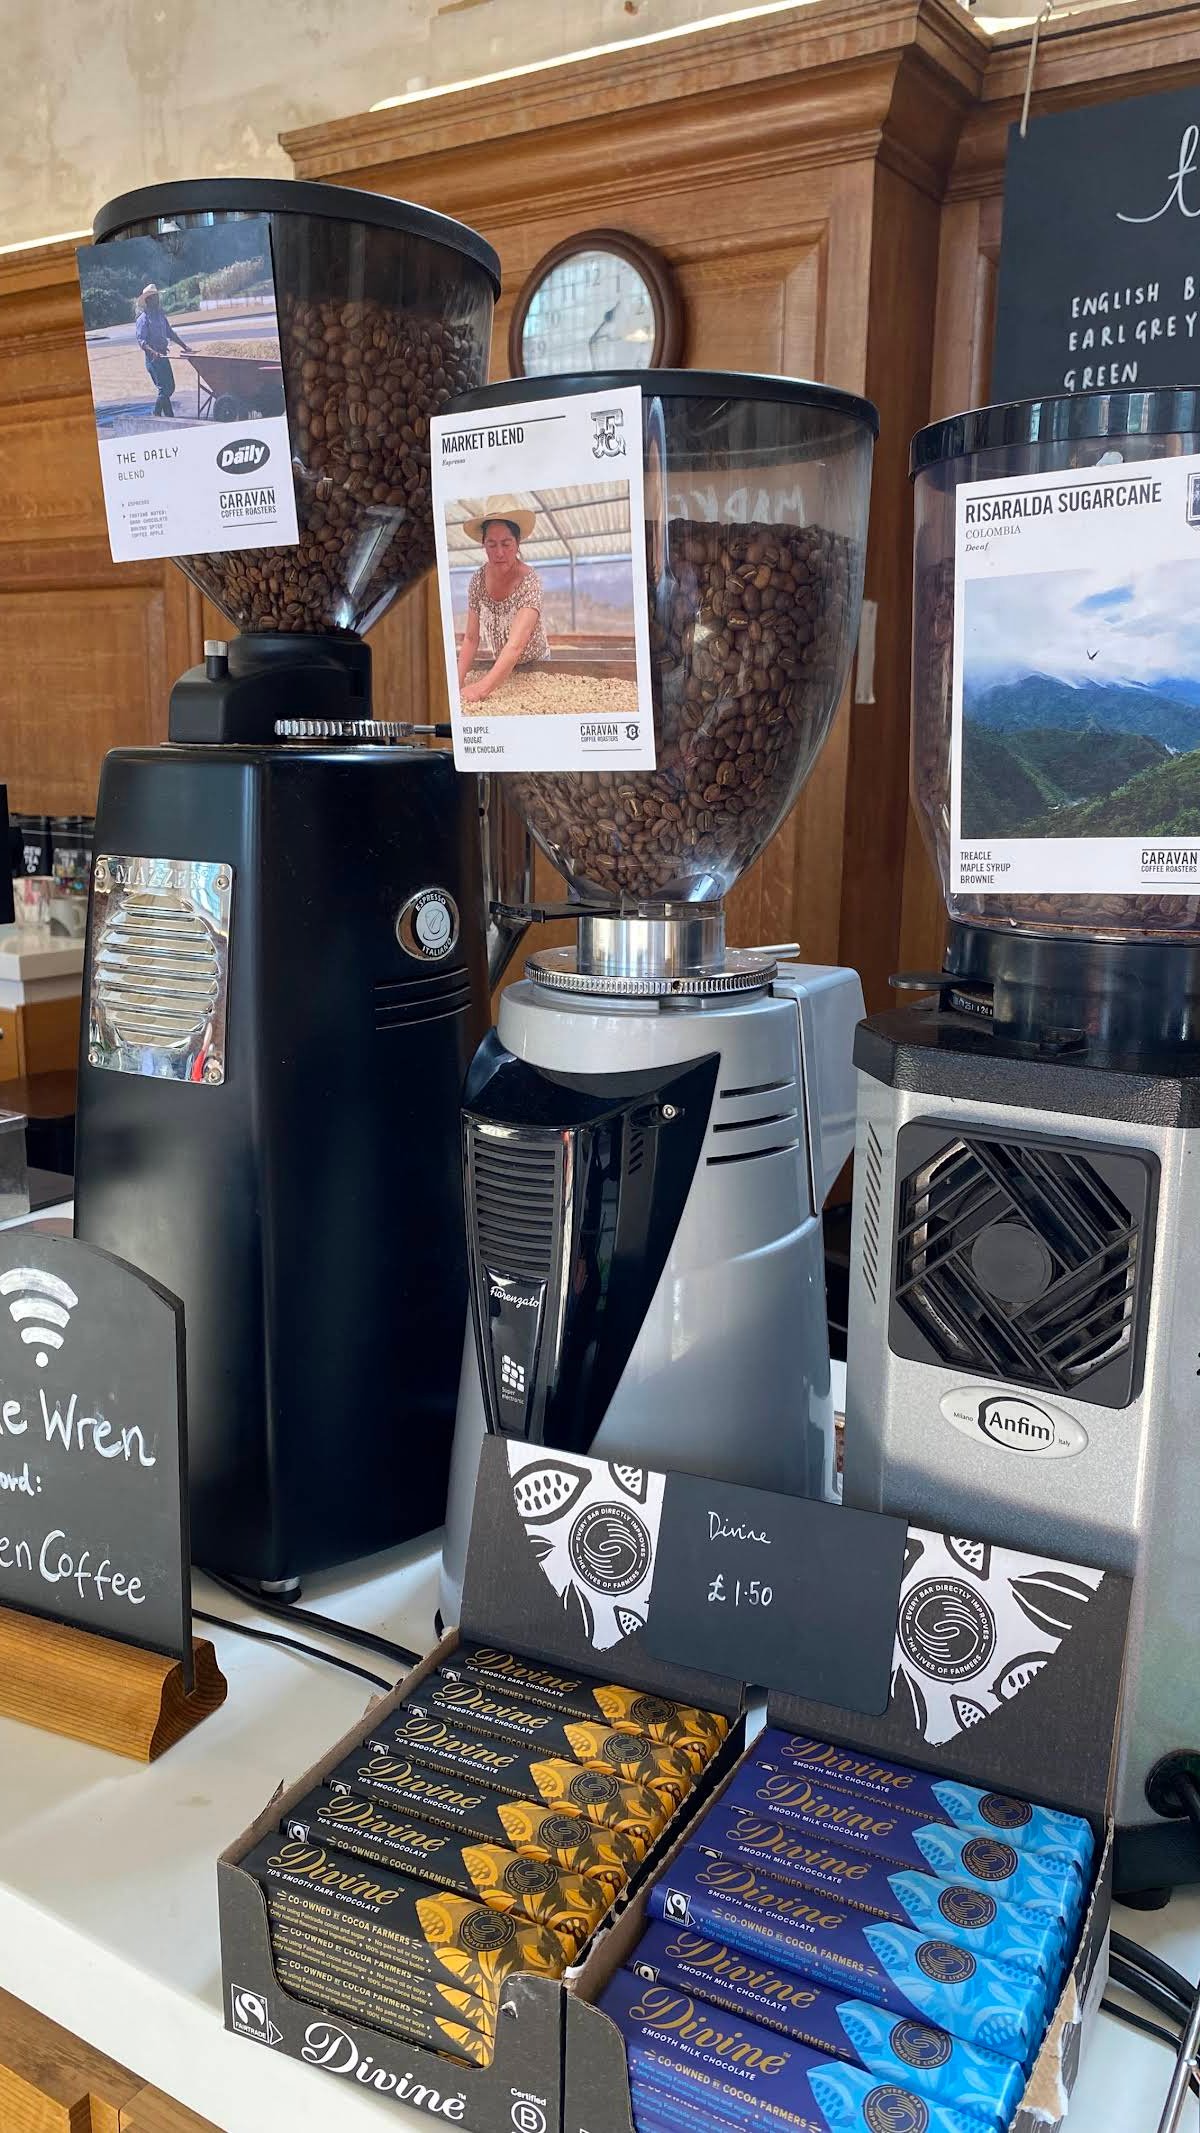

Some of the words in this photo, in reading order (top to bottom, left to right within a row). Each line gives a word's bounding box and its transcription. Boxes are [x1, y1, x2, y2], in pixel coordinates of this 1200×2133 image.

[1072, 282, 1159, 318] ENGLISH
[1069, 324, 1125, 351] EARL
[1136, 311, 1198, 344] GREY
[1064, 361, 1138, 391] GREEN
[117, 453, 136, 464] THE
[144, 447, 179, 461] DAILY
[221, 444, 265, 467] Daily
[442, 433, 484, 454] MARKET
[488, 427, 524, 448] BLEND
[118, 470, 144, 481] BLEND
[220, 489, 275, 509] CARAVAN
[221, 509, 243, 518] COFFEE
[246, 506, 276, 515] ROASTERS
[966, 495, 1053, 524] RISARALDA
[1058, 482, 1161, 513] SUGARCANE
[965, 542, 989, 552] Decaf
[966, 525, 1021, 539] COLOMBIA
[581, 725, 618, 736] CARAVAN
[960, 852, 991, 860] TREACLE
[960, 864, 984, 872] MAPLE
[986, 864, 1010, 872] SYRUP
[1141, 852, 1198, 864] CARAVAN
[960, 875, 994, 884] BROWNIE
[416, 893, 446, 911] ESPRESSO
[422, 938, 451, 956] ITALIANO
[490, 1286, 540, 1308] Fiorenzato
[0, 1400, 27, 1435] e
[40, 1389, 156, 1466] Wren
[953, 1411, 974, 1422] Milano
[989, 1412, 1050, 1441] Anfim
[1058, 1438, 1070, 1447] Italy
[576, 1517, 588, 1542] EVERY
[587, 1509, 600, 1522] BAR
[601, 1508, 632, 1522] DIRECTLY
[631, 1520, 646, 1558] IMPROVES
[708, 1511, 771, 1544] Divine
[576, 1555, 586, 1568] THE
[584, 1569, 601, 1586] LIVES
[613, 1570, 640, 1588] FARMERS
[906, 1596, 919, 1621] EVERY
[919, 1587, 934, 1598] BAR
[935, 1584, 971, 1600] DIRECTLY
[970, 1599, 989, 1640] IMPROVES
[465, 1649, 578, 1692] Divine
[907, 1637, 918, 1653] THE
[916, 1653, 935, 1671] LIVES
[950, 1655, 982, 1675] FARMERS
[480, 1669, 506, 1680] SMOOTH
[507, 1677, 524, 1685] DARK
[526, 1682, 564, 1697] CHOCOLATE
[432, 1682, 549, 1729] Divine
[448, 1704, 474, 1717] SMOOTH
[476, 1712, 493, 1722] DARK
[494, 1718, 534, 1735] CHOCOLATE
[394, 1718, 514, 1768] Divine
[409, 1742, 438, 1754] SMOOTH
[438, 1750, 457, 1761] DARK
[458, 1757, 499, 1774] CHOCOLATE
[781, 1736, 913, 1789] Divine
[793, 1760, 824, 1773] SMOOTH
[826, 1770, 843, 1778] MILK
[845, 1775, 890, 1793] CHOCOLATE
[357, 1756, 481, 1808] Divine
[372, 1781, 401, 1794] SMOOTH
[402, 1791, 421, 1801] DARK
[423, 1797, 465, 1815] CHOCOLATE
[756, 1774, 893, 1836] Divine
[768, 1804, 801, 1819] SMOOTH
[802, 1815, 820, 1826] MILK
[822, 1822, 869, 1841] CHOCOLATE
[317, 1796, 445, 1852] Divine
[332, 1822, 362, 1835] SMOOTH
[363, 1832, 383, 1844] DARK
[384, 1839, 428, 1859] CHOCOLATE
[337, 1840, 380, 1861] CO-OWNED
[390, 1859, 417, 1876] COCOA
[419, 1869, 456, 1888] FARMERS
[726, 1817, 868, 1880] Divine
[738, 1845, 771, 1860] SMOOTH
[773, 1857, 792, 1867] MILK
[794, 1863, 842, 1884] CHOCOLATE
[267, 1842, 400, 1905] Divine
[267, 1869, 281, 1877] 70%
[282, 1874, 313, 1888] SMOOTH
[314, 1886, 335, 1896] DARK
[336, 1893, 381, 1914] CHOCOLATE
[695, 1862, 843, 1929] Divine
[708, 1889, 742, 1906] SMOOTH
[743, 1903, 764, 1914] MILK
[765, 1910, 816, 1934] CHOCOLATE
[814, 1887, 845, 1904] COCOA
[848, 1900, 889, 1918] FARMERS
[288, 1895, 331, 1916] CO-OWNED
[342, 1914, 370, 1931] COCOA
[372, 1924, 410, 1946] FARMERS
[724, 1912, 773, 1937] CO-OWNED
[785, 1936, 818, 1955] COCOA
[821, 1950, 864, 1972] FARMERS
[290, 1961, 332, 1982] CO-OWNED
[665, 1932, 816, 2008] Divine
[677, 1963, 713, 1981] SMOOTH
[714, 1978, 734, 1990] MILK
[736, 1987, 788, 2013] CHOCOLATE
[235, 2022, 266, 2039] FAIRTRADE
[629, 1987, 786, 2075] Divine
[693, 1987, 744, 2015] CO-OWNED
[756, 2014, 788, 2033] COCOA
[792, 2028, 836, 2053] FARMERS
[301, 2022, 465, 2120] Divine
[641, 2027, 678, 2046] SMOOTH
[680, 2044, 701, 2057] MILK
[703, 2054, 756, 2081] CHOCOLATE
[511, 2088, 546, 2106] Certified
[658, 2056, 711, 2085] CO-OWNED
[722, 2084, 757, 2106] COCOA
[760, 2101, 807, 2128] FARMERS
